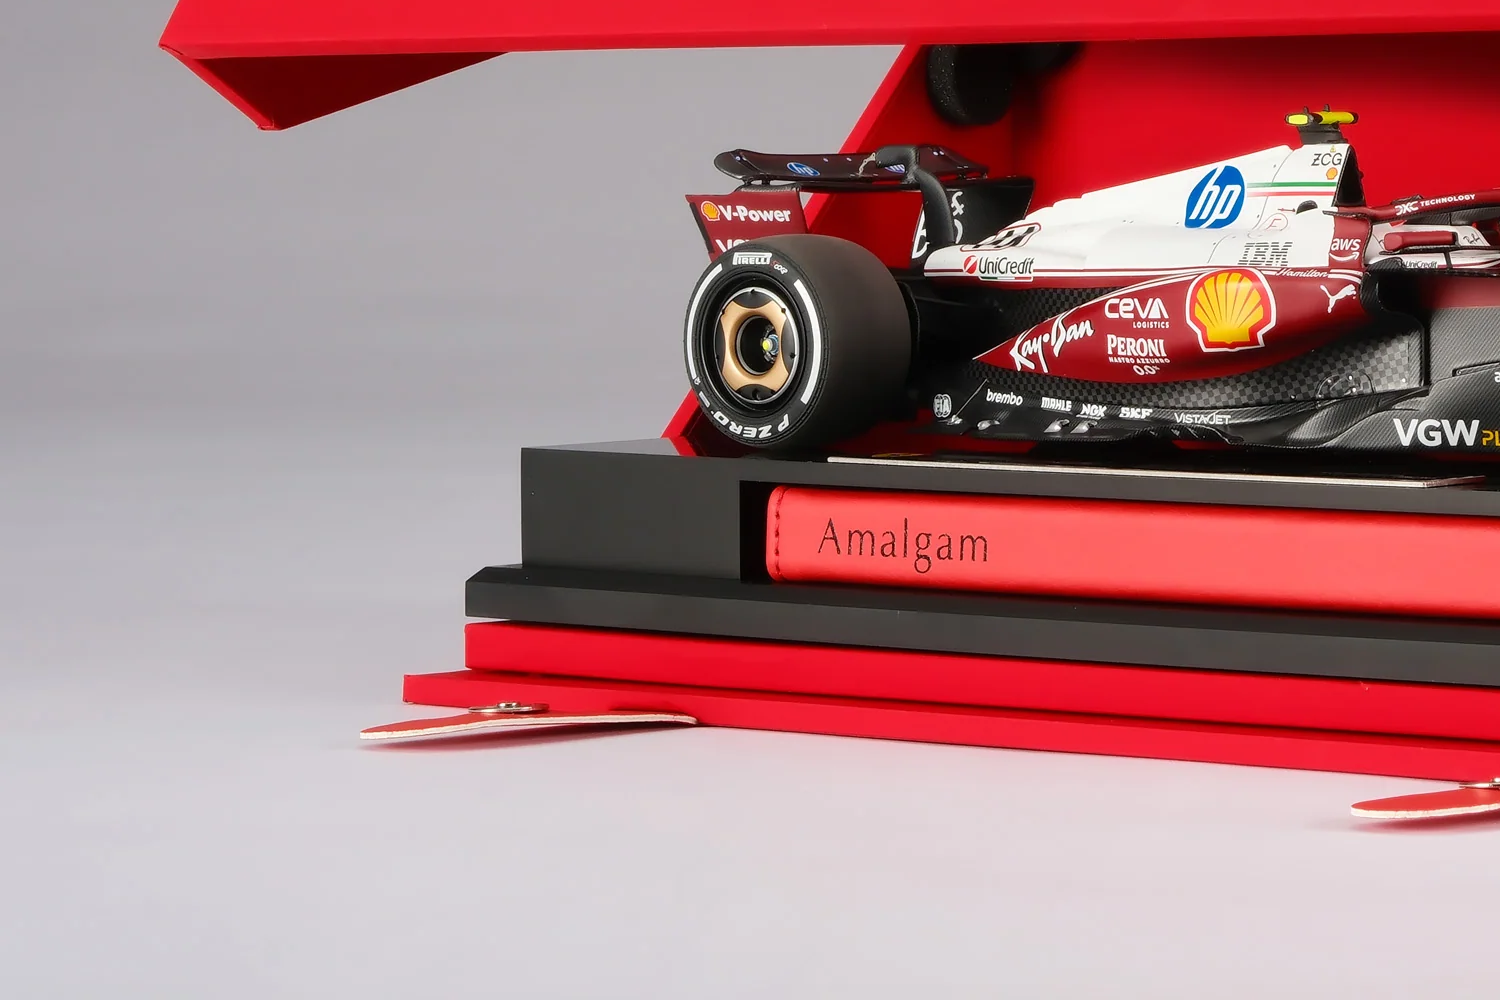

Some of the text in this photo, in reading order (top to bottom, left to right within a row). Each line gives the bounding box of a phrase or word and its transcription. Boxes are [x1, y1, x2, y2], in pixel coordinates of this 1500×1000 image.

[1188, 166, 1242, 228] hp
[1420, 193, 1476, 207] TECHNOLOGY
[718, 205, 790, 222] V-Power
[1331, 237, 1361, 251] aws
[732, 252, 772, 265] PIRELLI
[1238, 241, 1293, 266] IBM
[978, 257, 1035, 275] UniCredit
[1275, 268, 1329, 278] Hamilton
[1107, 334, 1167, 357] PERONI
[1109, 356, 1135, 364] NASTRO
[986, 389, 1023, 406] brembo
[1041, 397, 1072, 412] MAHLE
[1081, 403, 1107, 418] NGK
[1119, 406, 1153, 419] SKF
[713, 410, 790, 438] P ZERO
[1393, 418, 1480, 447] VGW
[818, 517, 988, 573] Amalgam
